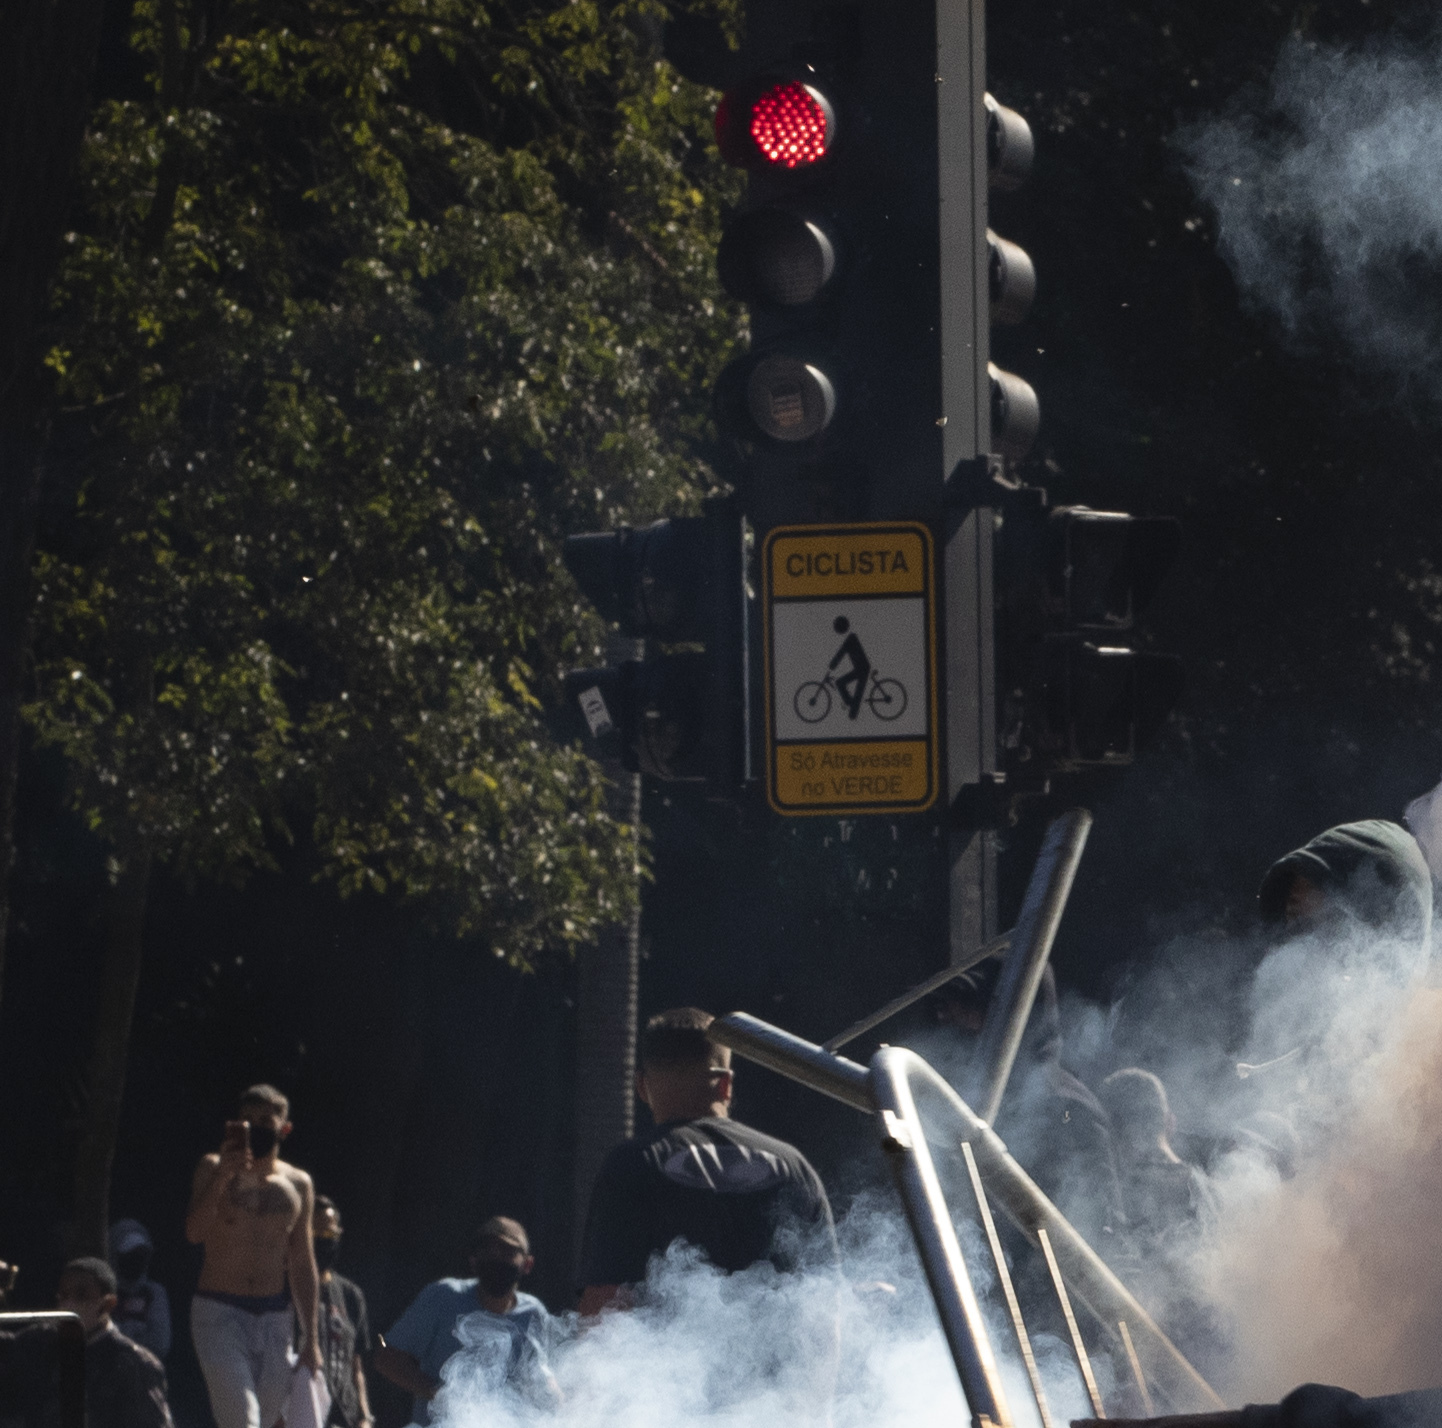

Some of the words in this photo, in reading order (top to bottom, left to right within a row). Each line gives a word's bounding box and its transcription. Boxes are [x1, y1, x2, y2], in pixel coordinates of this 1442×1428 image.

[786, 550, 908, 577] CICLISTA
[790, 752, 815, 772] Só
[821, 750, 913, 769] Atravesse
[801, 781, 824, 797] no
[832, 776, 904, 796] VERDE
